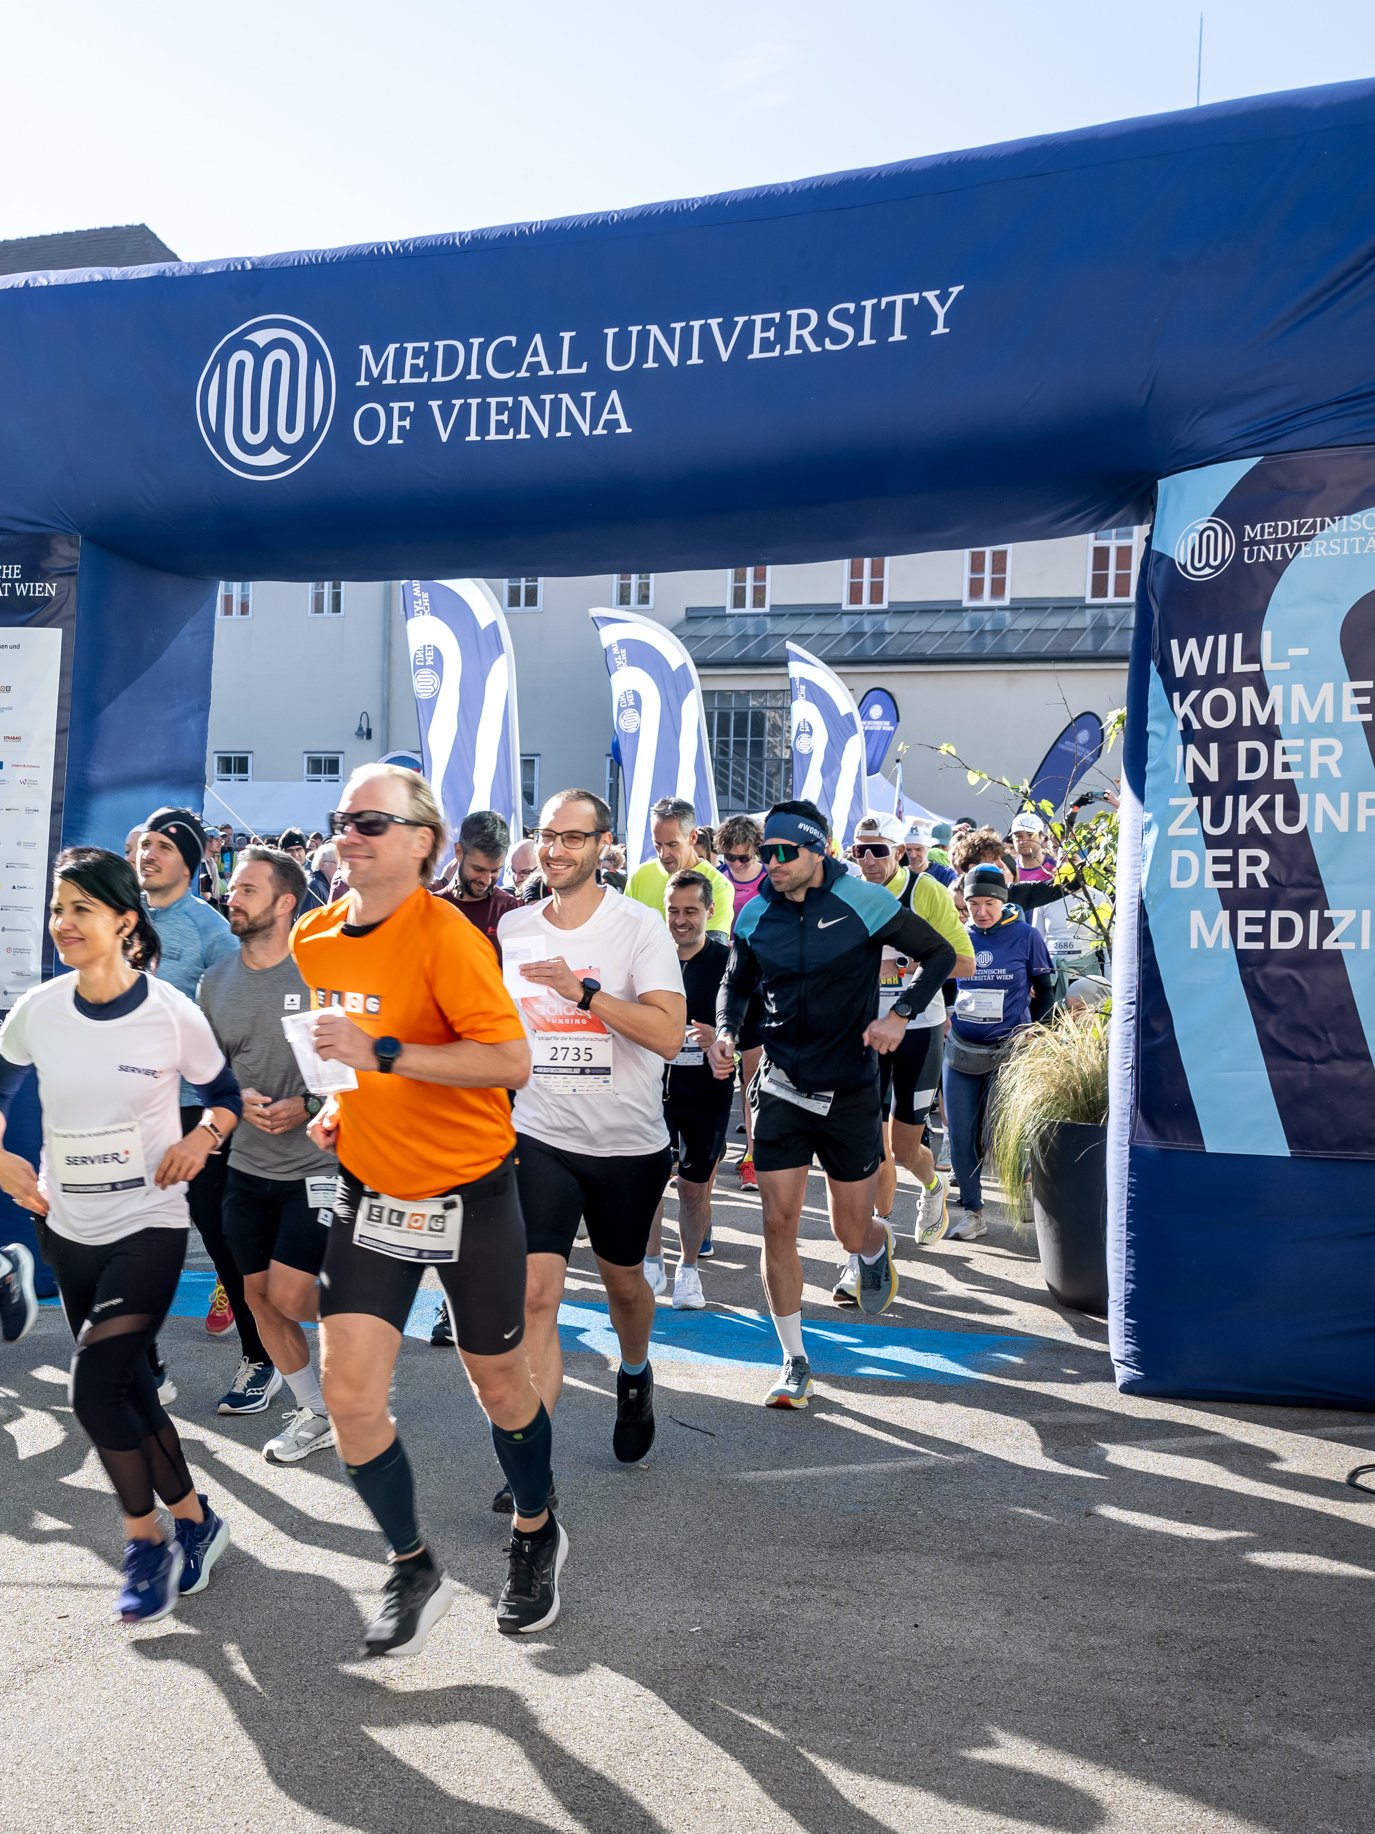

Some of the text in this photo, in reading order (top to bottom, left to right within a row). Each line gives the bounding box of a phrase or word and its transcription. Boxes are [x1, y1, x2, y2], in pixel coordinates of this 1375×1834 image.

[355, 284, 965, 386] MEDICAL UNIVERSITY
[353, 389, 633, 446] OF VIENNA
[15, 583, 57, 597] WIEN
[1170, 631, 1310, 678] WILL-
[1172, 680, 1374, 731] KOMME
[1174, 738, 1344, 784] IN DER
[1170, 848, 1270, 889] DER
[1190, 909, 1371, 950] MEDIZI
[549, 1046, 593, 1062] 2735
[64, 1152, 129, 1167] SERVIER
